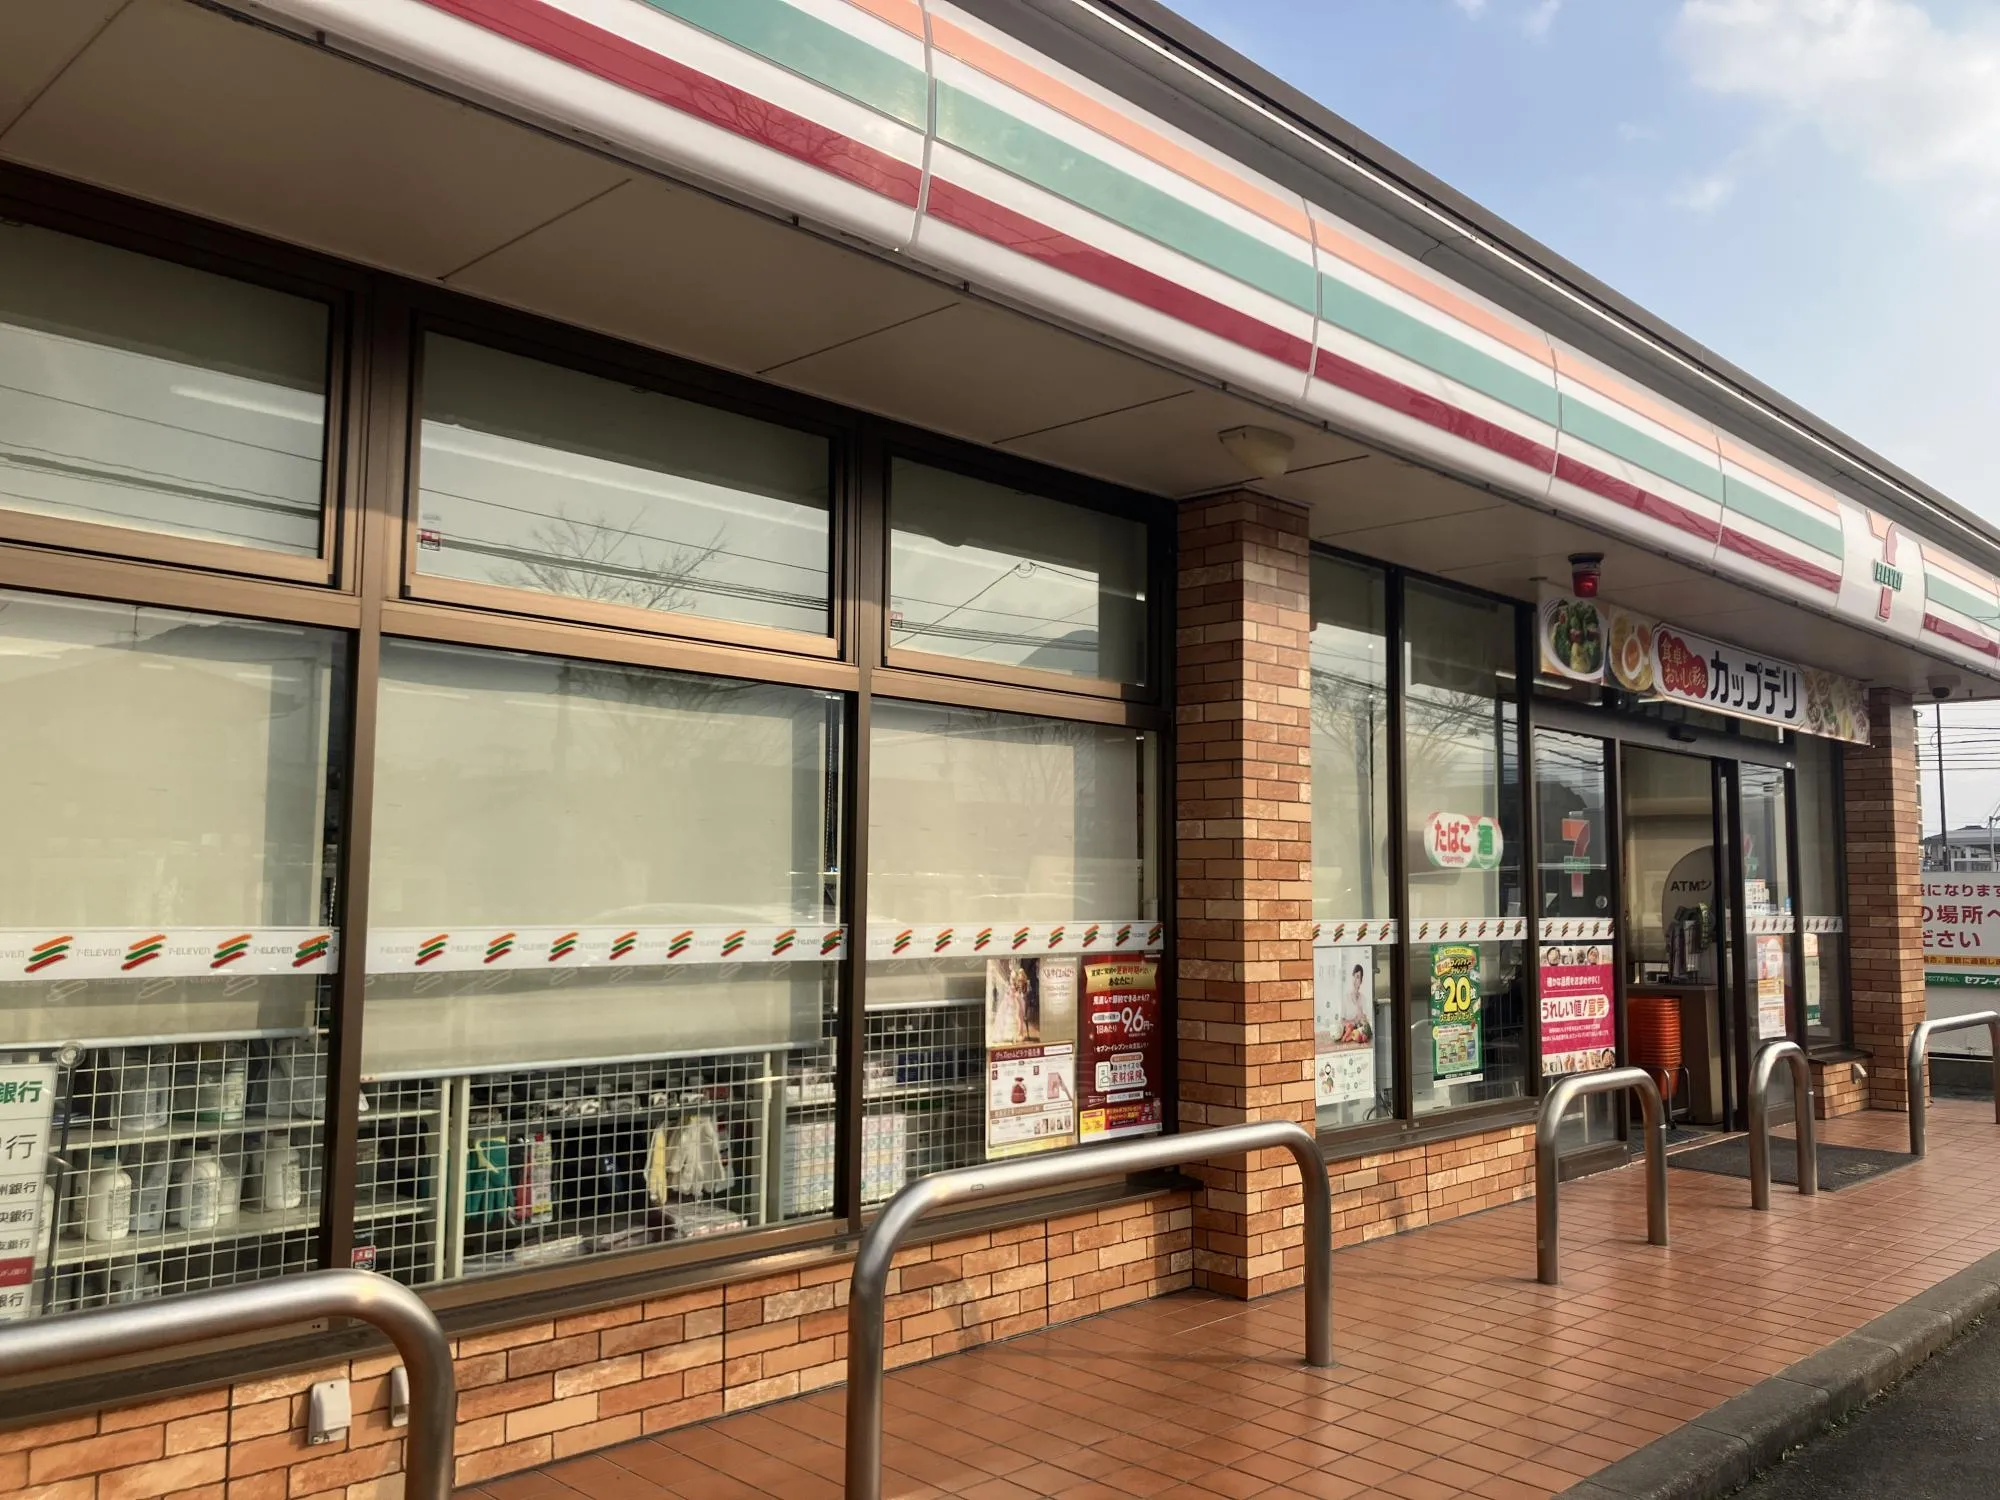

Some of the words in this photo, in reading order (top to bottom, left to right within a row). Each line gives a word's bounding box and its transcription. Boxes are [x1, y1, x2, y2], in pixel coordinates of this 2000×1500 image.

[1711, 651, 1797, 719] カップデリ
[1434, 820, 1471, 853] たばこ
[1670, 880, 1700, 892] ATM
[1921, 883, 2000, 897] になります
[1541, 997, 1605, 1020] うれしい値!宣言
[0, 1134, 38, 1160] 行
